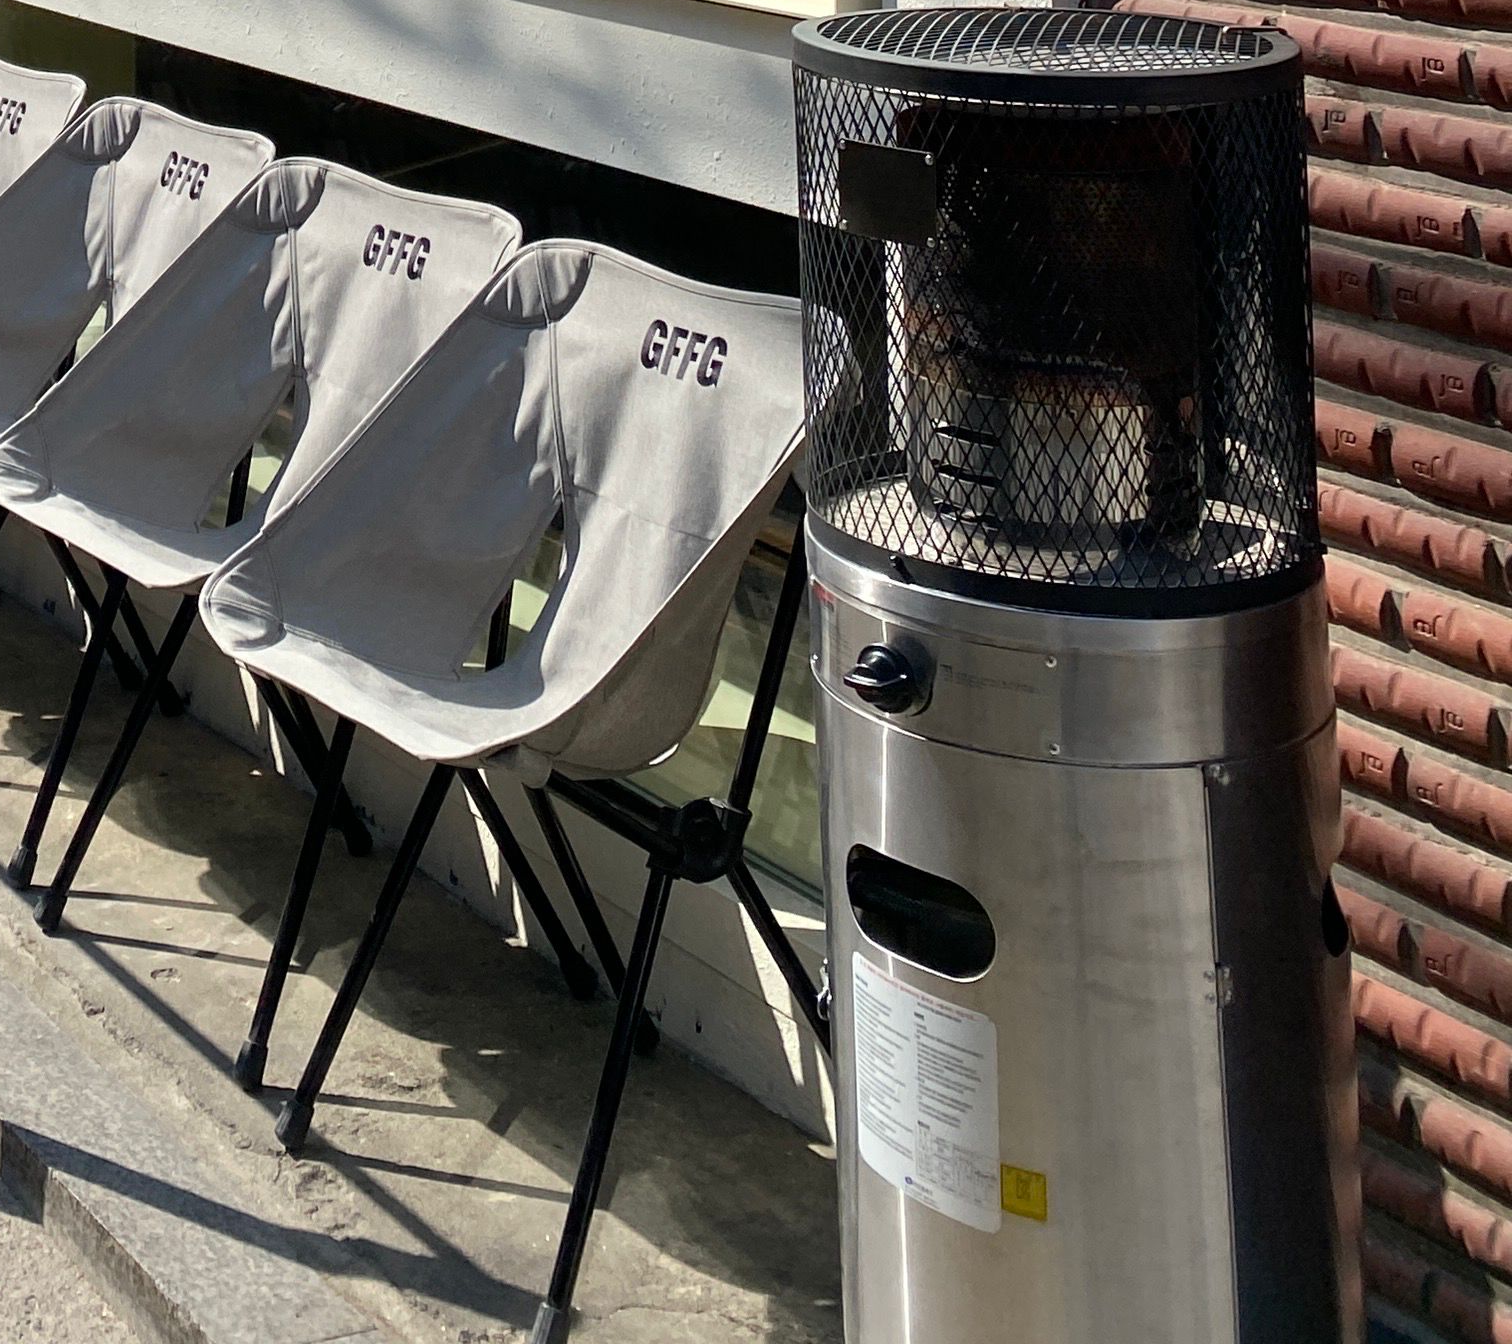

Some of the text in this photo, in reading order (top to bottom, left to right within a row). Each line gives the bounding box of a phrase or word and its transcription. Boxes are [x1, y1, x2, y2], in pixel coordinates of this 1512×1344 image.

[160, 150, 209, 201] GFFG
[362, 223, 431, 280] GFFG
[639, 318, 728, 388] GFFG
